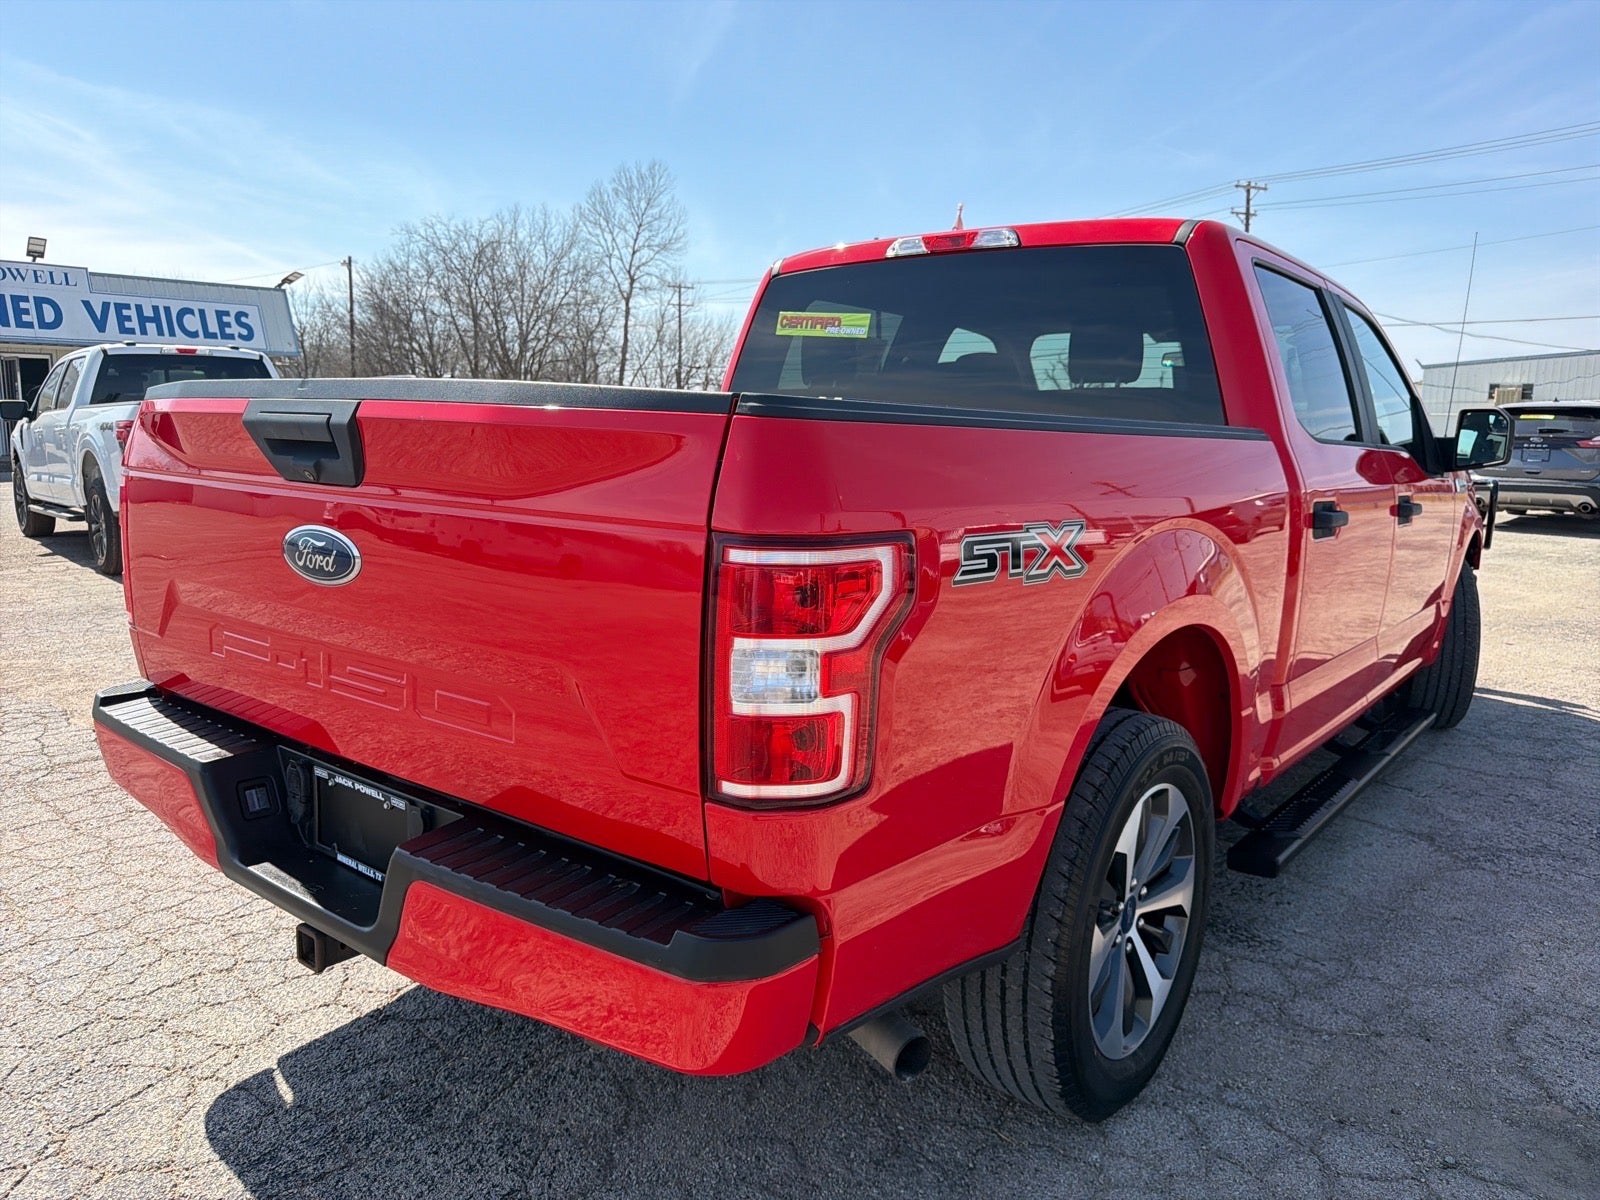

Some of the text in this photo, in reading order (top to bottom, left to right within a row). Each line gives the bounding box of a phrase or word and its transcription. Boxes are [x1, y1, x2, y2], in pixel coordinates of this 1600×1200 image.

[81, 299, 255, 342] VEHICLES
[780, 315, 842, 330] CERTIFIED
[825, 326, 866, 336] PRE-OWNED
[295, 536, 337, 573] Ford
[952, 519, 1088, 587] STX
[334, 775, 385, 801] JACK POWELL
